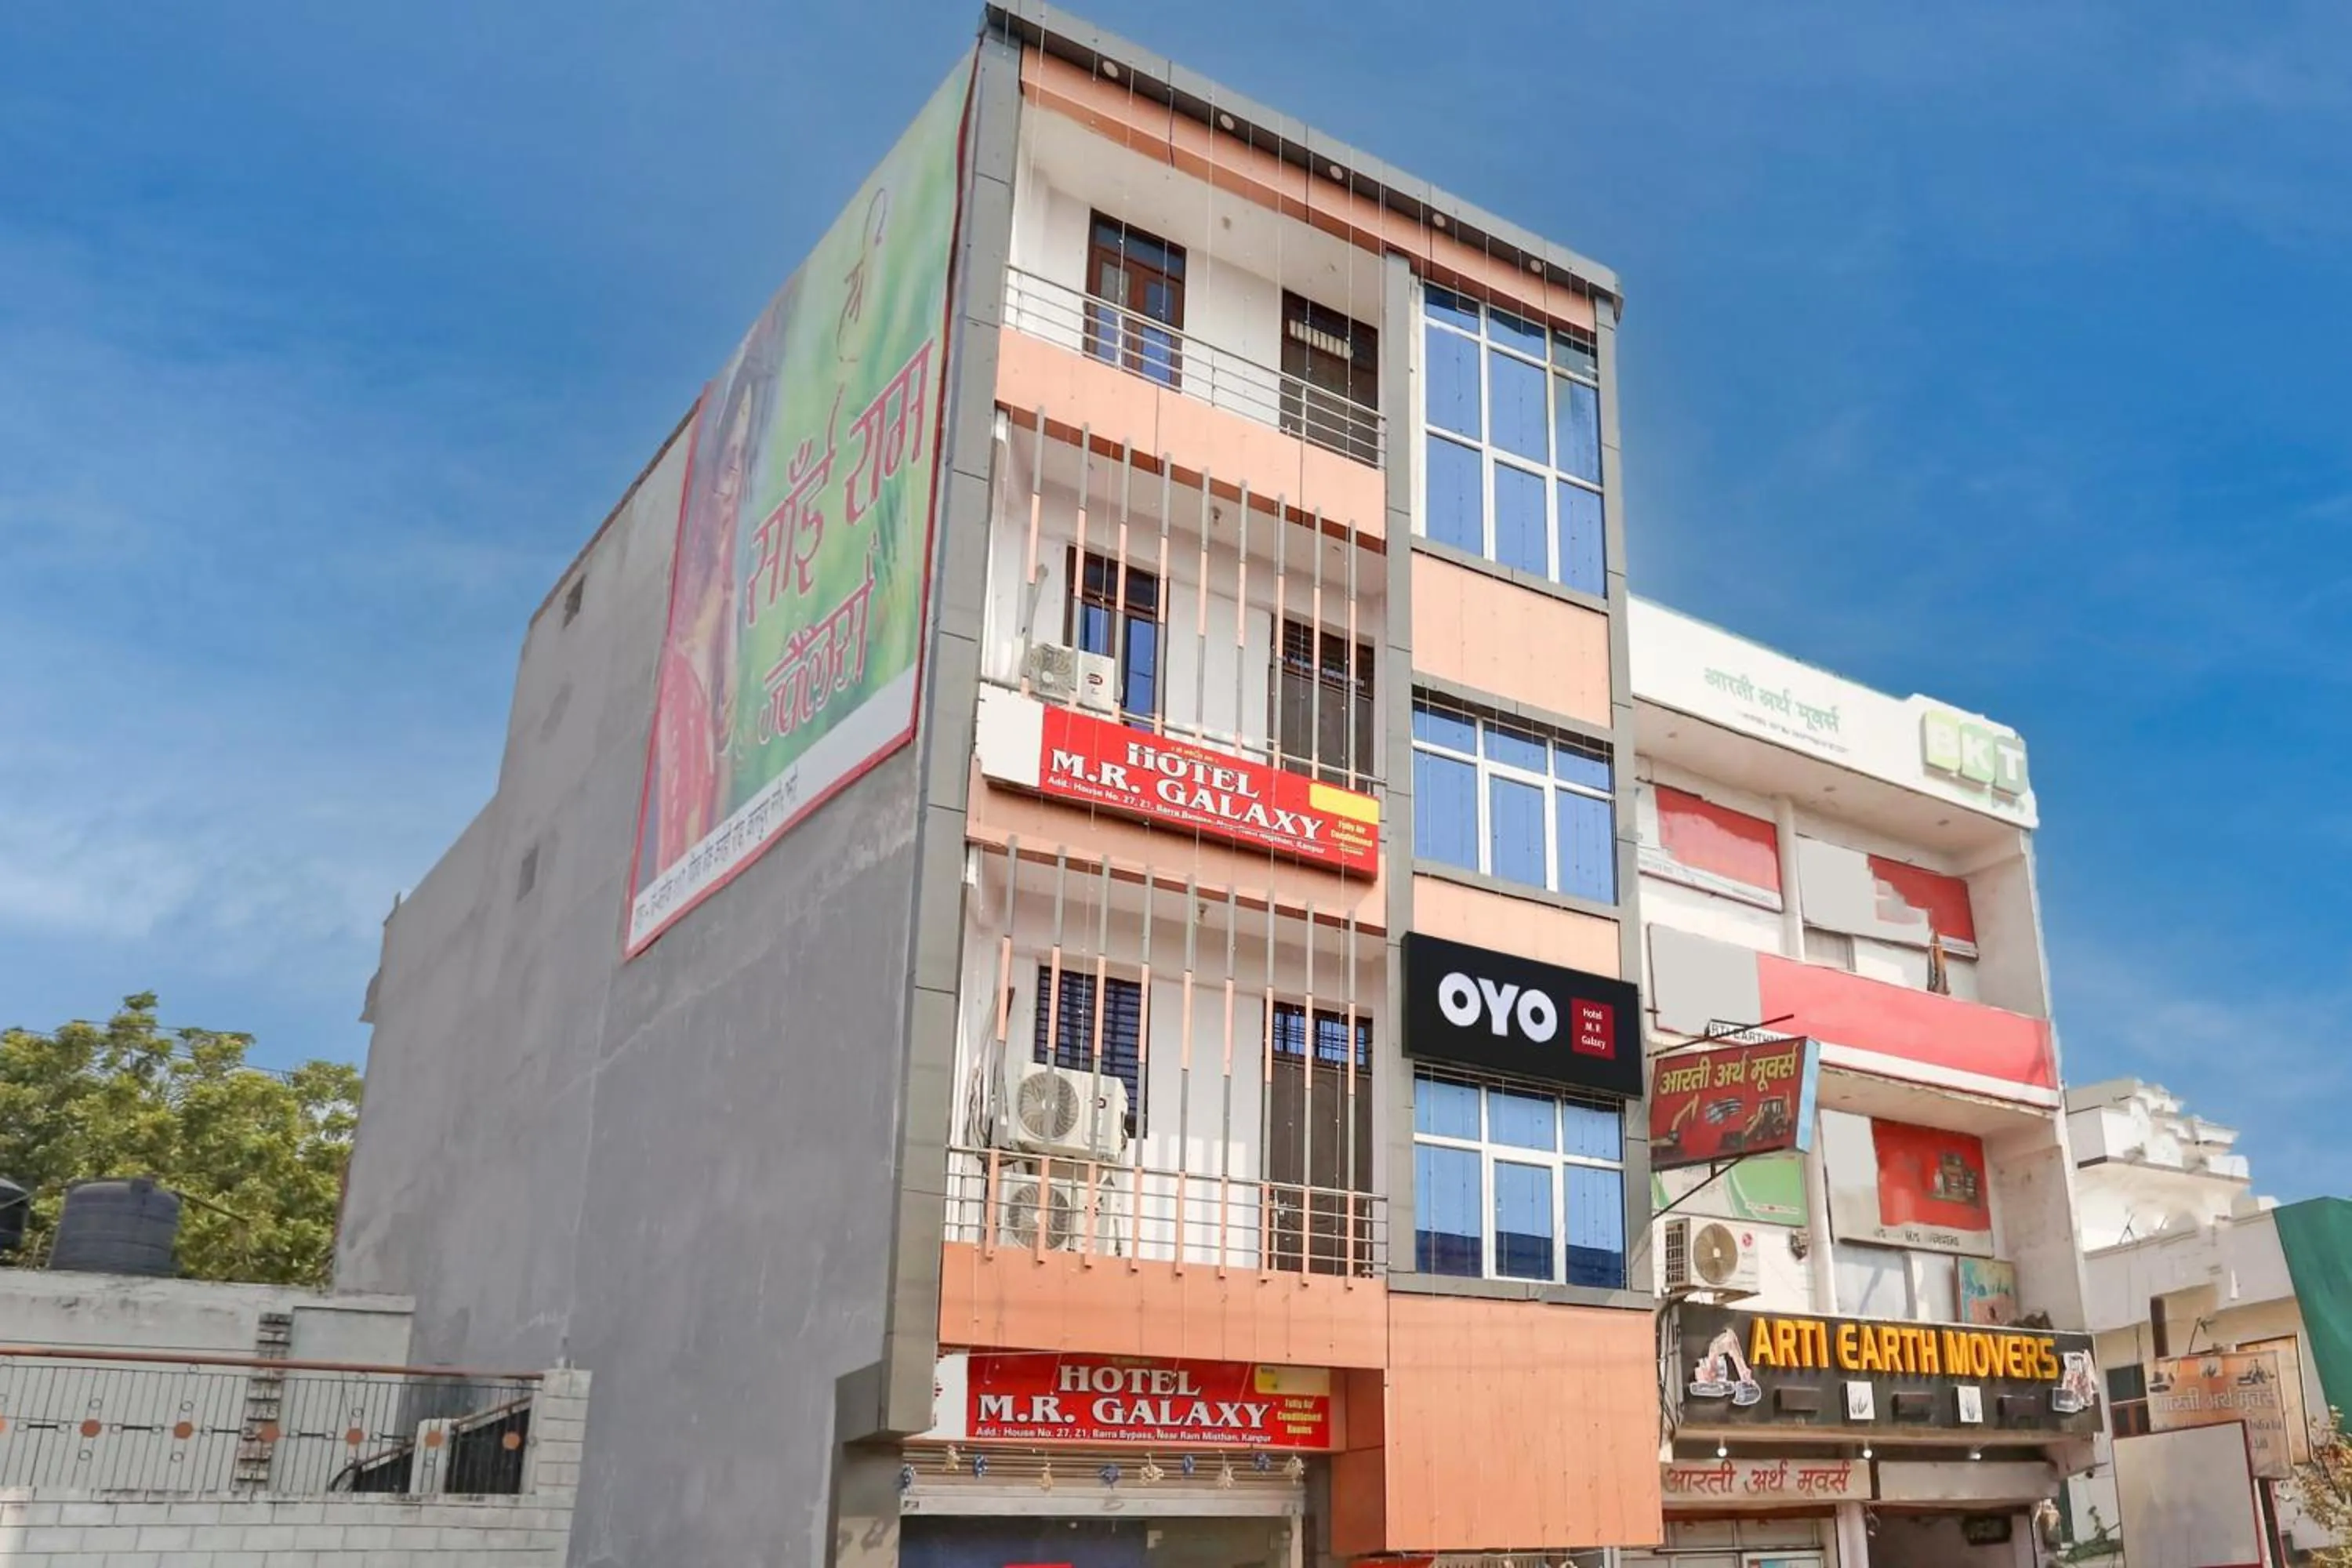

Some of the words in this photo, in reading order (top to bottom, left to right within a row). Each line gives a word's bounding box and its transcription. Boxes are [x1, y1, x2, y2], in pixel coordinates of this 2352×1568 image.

[844, 337, 935, 526] राम
[1074, 783, 1103, 797] House
[1127, 742, 1260, 799] HOTEL
[1051, 748, 1142, 793] M.R.
[1156, 779, 1323, 840] GALAXY
[1438, 971, 1558, 1044] OYO
[1583, 1007, 1603, 1020] Hotel
[1658, 1057, 1711, 1094] आरती
[1715, 1051, 1750, 1087] अर्थ
[1751, 1043, 1798, 1091] मूवर्स
[1750, 1316, 1829, 1368] ARTI
[1835, 1323, 1940, 1375] EARTH
[1942, 1330, 2060, 1380] MOVERS
[1059, 1365, 1201, 1396] HOTEL
[978, 1394, 1076, 1423] M.R.
[1092, 1397, 1270, 1428] GALAXY
[1003, 1427, 1035, 1437] House
[1241, 1432, 1272, 1443] Kanpur
[1664, 1459, 1737, 1495] आरती
[1744, 1459, 1788, 1494] अर्थ
[1797, 1460, 1850, 1497] मूवर्स
